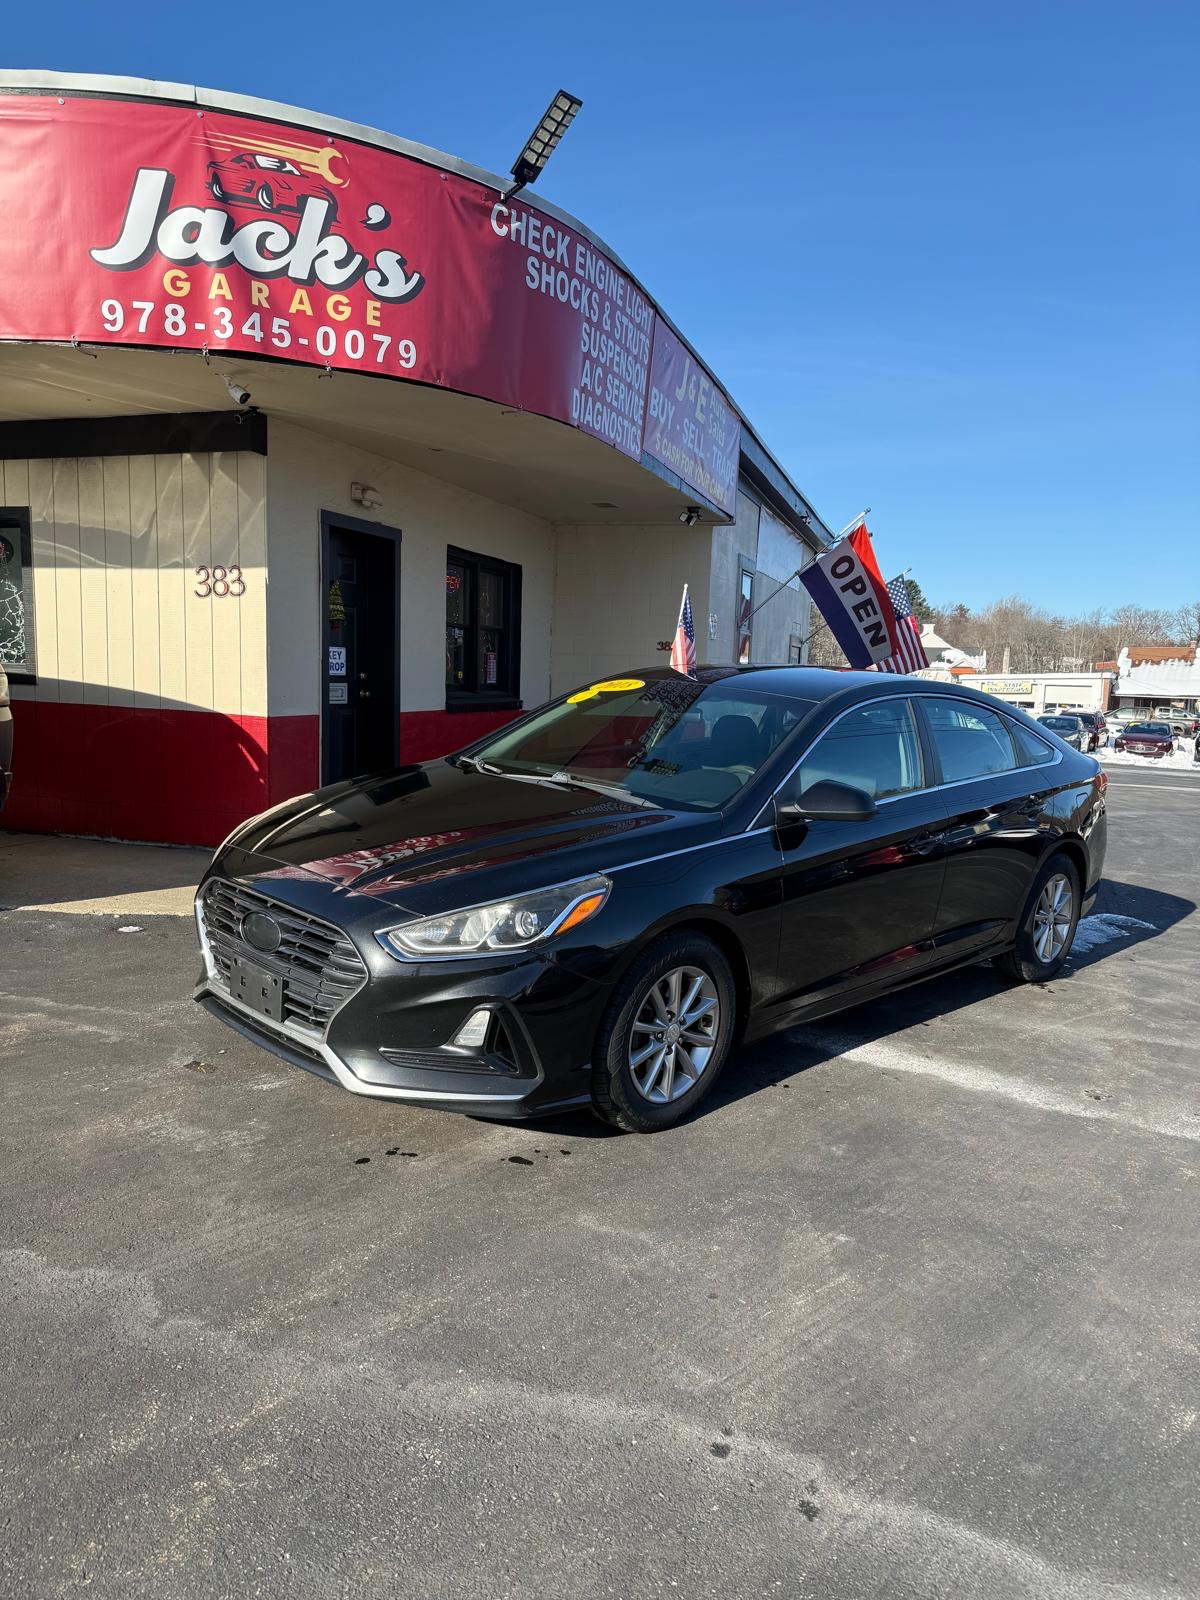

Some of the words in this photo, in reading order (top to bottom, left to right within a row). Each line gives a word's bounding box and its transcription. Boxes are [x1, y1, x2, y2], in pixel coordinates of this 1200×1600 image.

[90, 168, 424, 303] Jack's
[490, 202, 571, 269] CHECK
[575, 243, 625, 307] ENGINE
[626, 285, 654, 332] LIGHT
[163, 269, 382, 328] GARAGE
[525, 255, 600, 323] SHOCKS
[602, 304, 611, 330] &
[614, 311, 650, 364] STRUTS
[101, 299, 417, 369] 978-345-0079
[580, 322, 647, 396] SUSPENSION
[572, 388, 642, 456] DIAGNOSTICS
[580, 360, 602, 396] A/C
[605, 373, 645, 426] SERVICE
[675, 356, 690, 402] J
[688, 374, 697, 403] &
[695, 376, 710, 425] E
[650, 387, 675, 430] BUY
[682, 417, 705, 460] SELL
[712, 446, 736, 487] TRADE
[195, 565, 246, 599] 383
[830, 554, 888, 649] OPEN
[329, 662, 345, 672] ROP
[656, 641, 673, 652] 38
